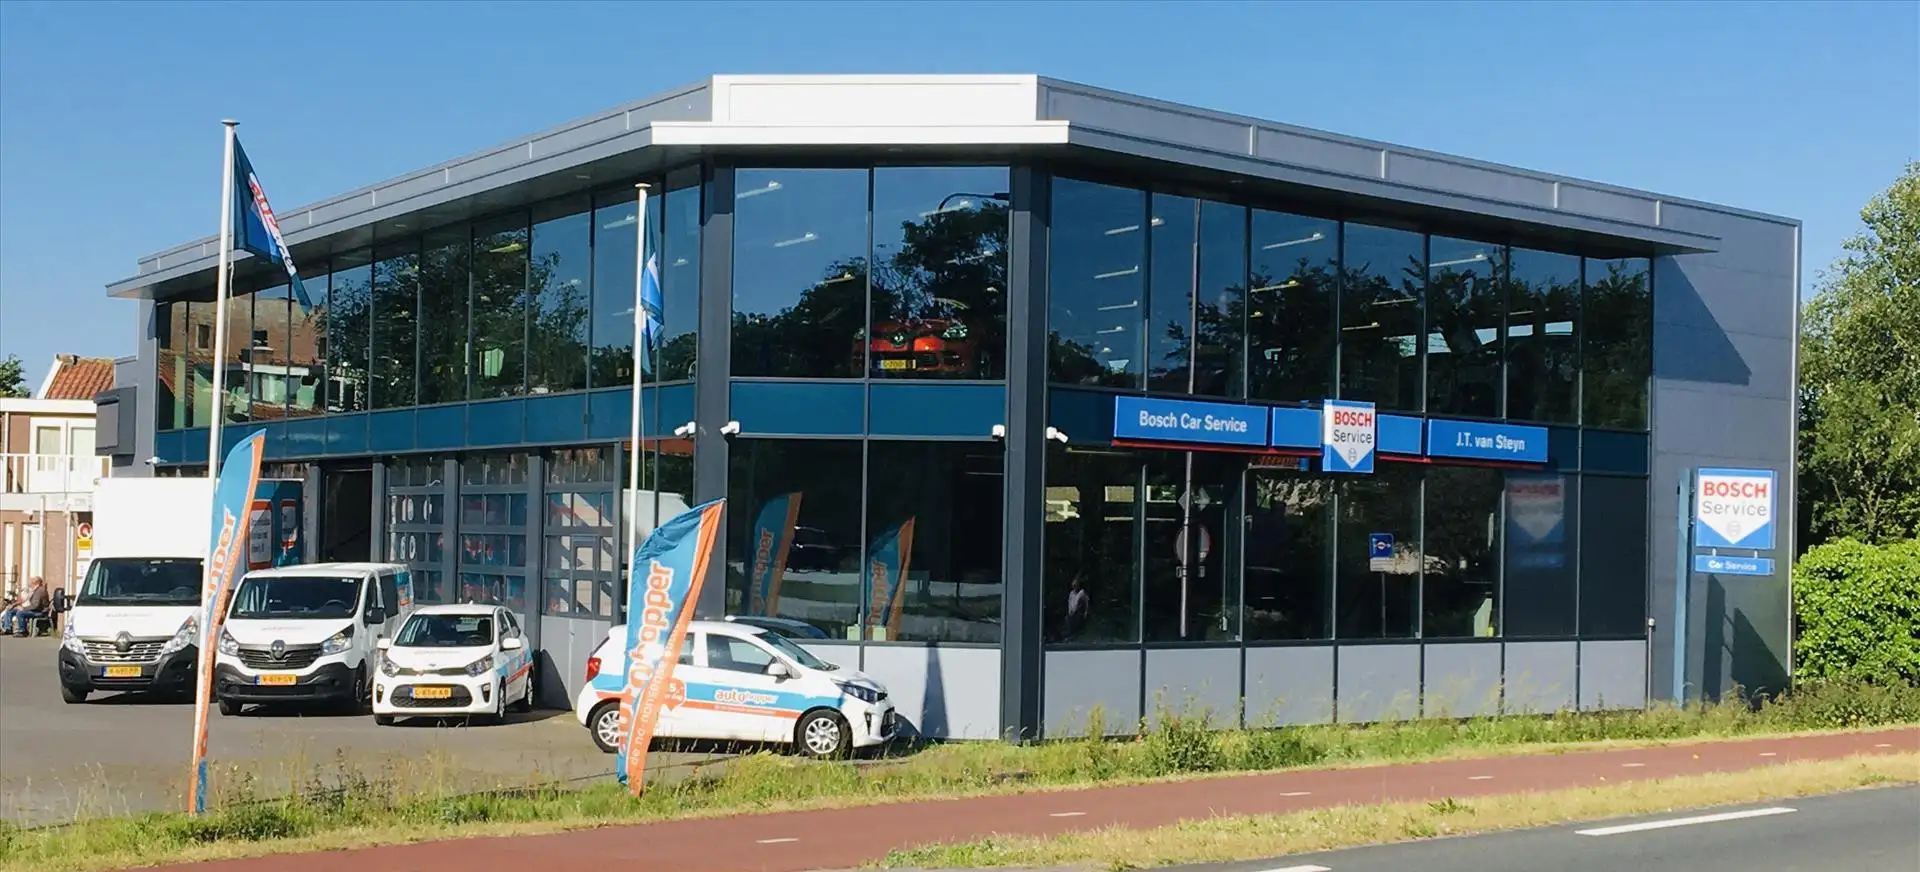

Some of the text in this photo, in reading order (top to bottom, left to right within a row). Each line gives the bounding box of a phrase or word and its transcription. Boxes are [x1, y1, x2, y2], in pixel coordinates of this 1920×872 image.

[1139, 410, 1247, 432] Bosch Car Service
[1334, 411, 1372, 427] BOSCH
[1333, 429, 1372, 444] Service
[1456, 431, 1525, 453] J.T. van Steyn
[1703, 481, 1767, 498] BOSCH
[1702, 500, 1767, 517] Service
[1708, 560, 1757, 571] Car Service
